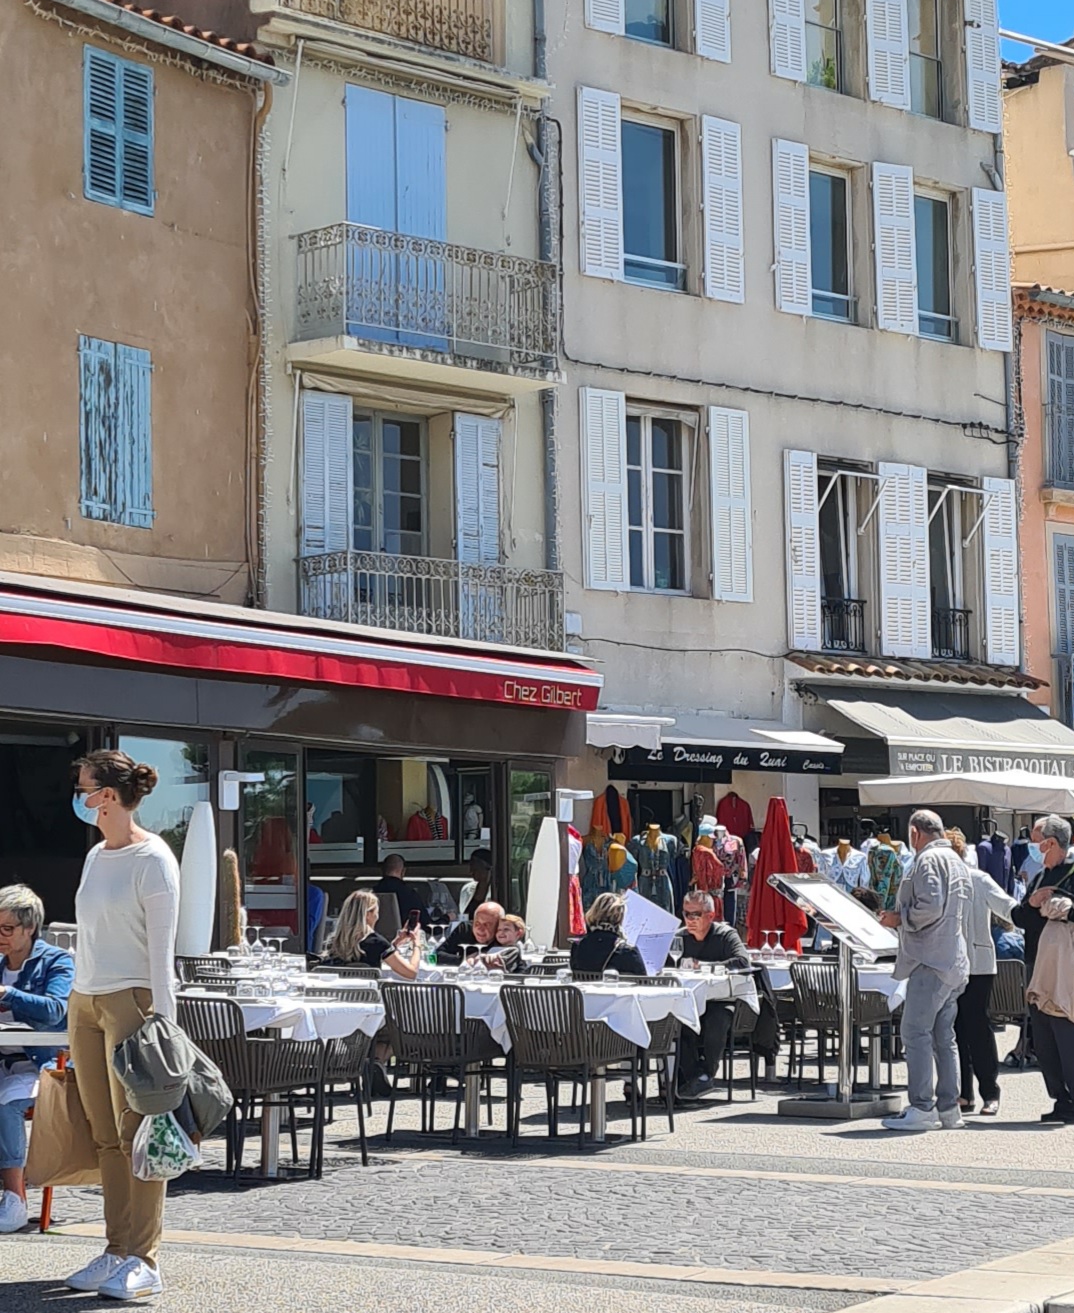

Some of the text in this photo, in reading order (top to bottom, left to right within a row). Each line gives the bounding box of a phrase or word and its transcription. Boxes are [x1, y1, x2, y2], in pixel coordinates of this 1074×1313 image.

[504, 681, 582, 706] Chez Gilbert
[647, 746, 788, 768] Le Dressing du Quai
[940, 754, 964, 774] LE
